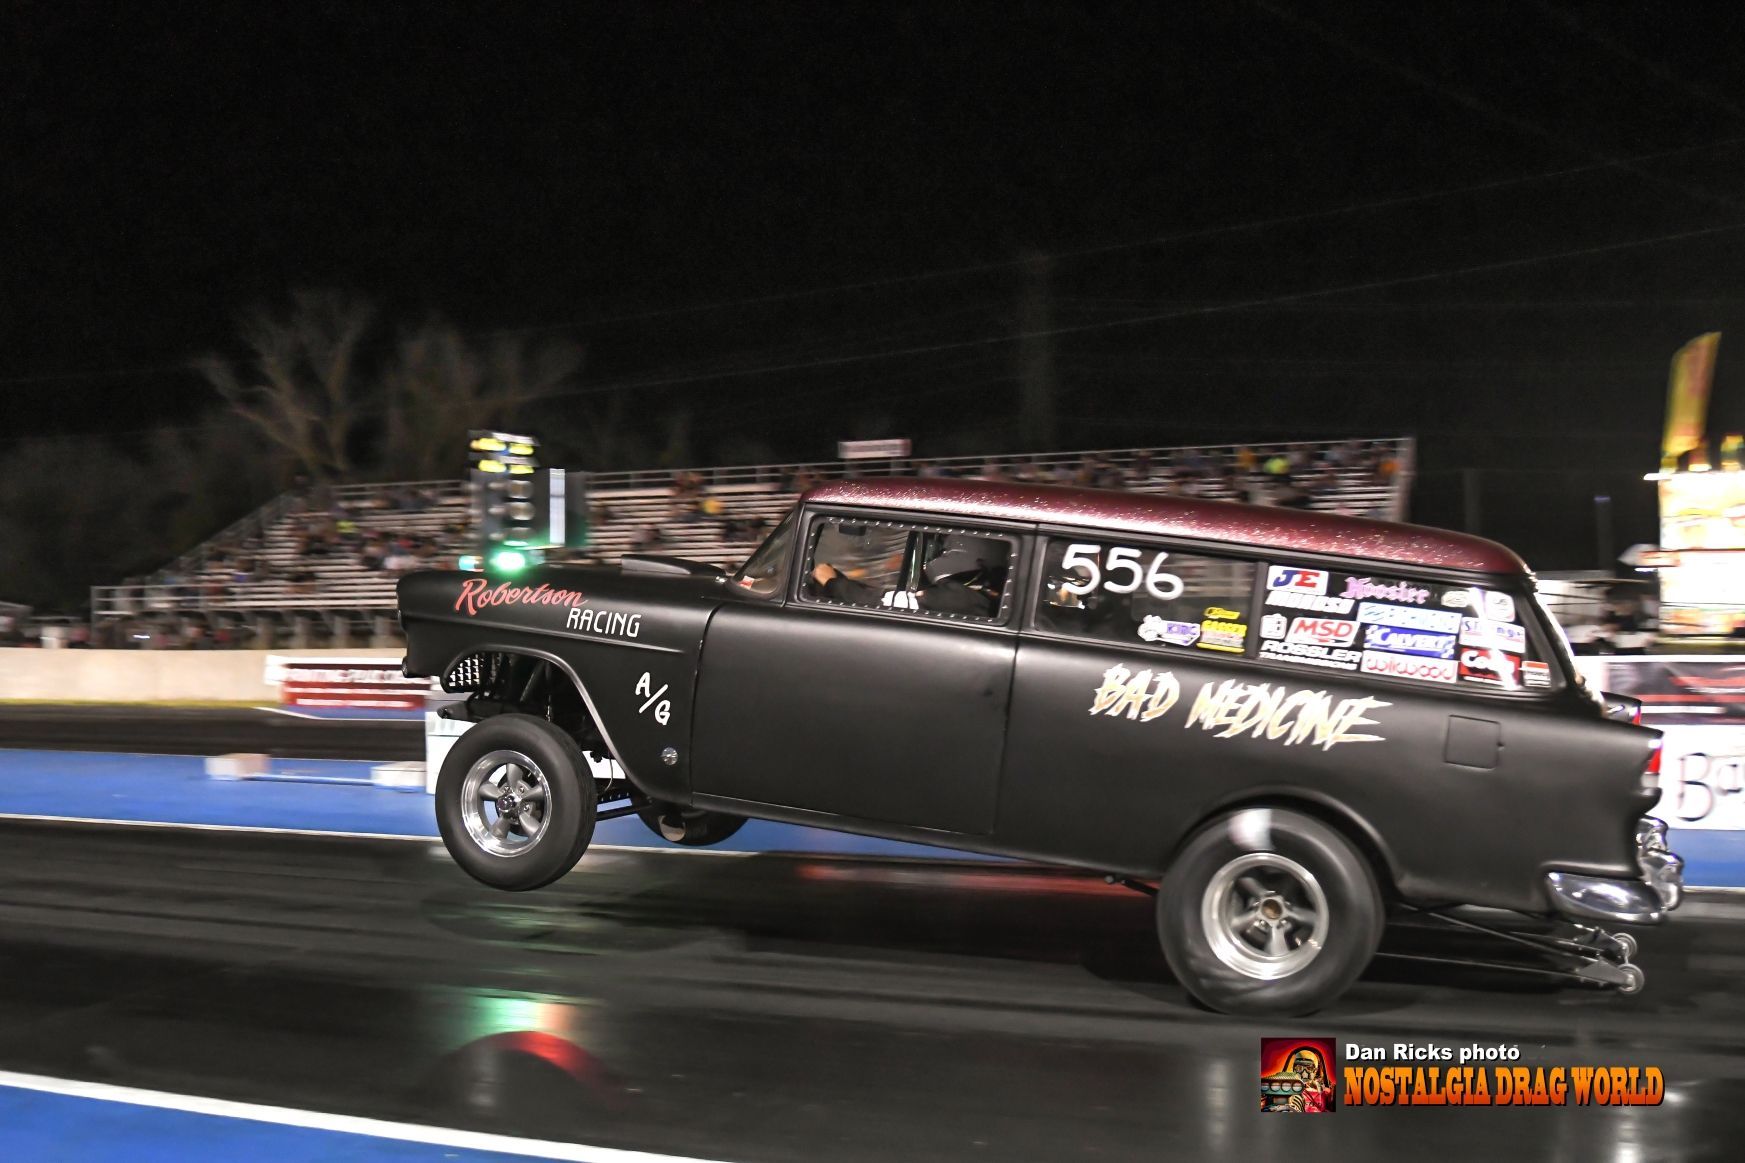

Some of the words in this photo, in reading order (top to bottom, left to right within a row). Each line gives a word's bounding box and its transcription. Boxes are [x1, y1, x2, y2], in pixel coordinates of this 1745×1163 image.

[1062, 543, 1184, 600] 556
[1273, 569, 1320, 588] JE
[455, 578, 588, 616] Robertson
[566, 607, 642, 638] RACING
[1294, 619, 1354, 638] MSD
[635, 671, 672, 726] A/G
[1088, 663, 1180, 722] BAD
[1184, 678, 1393, 751] MEDICINE
